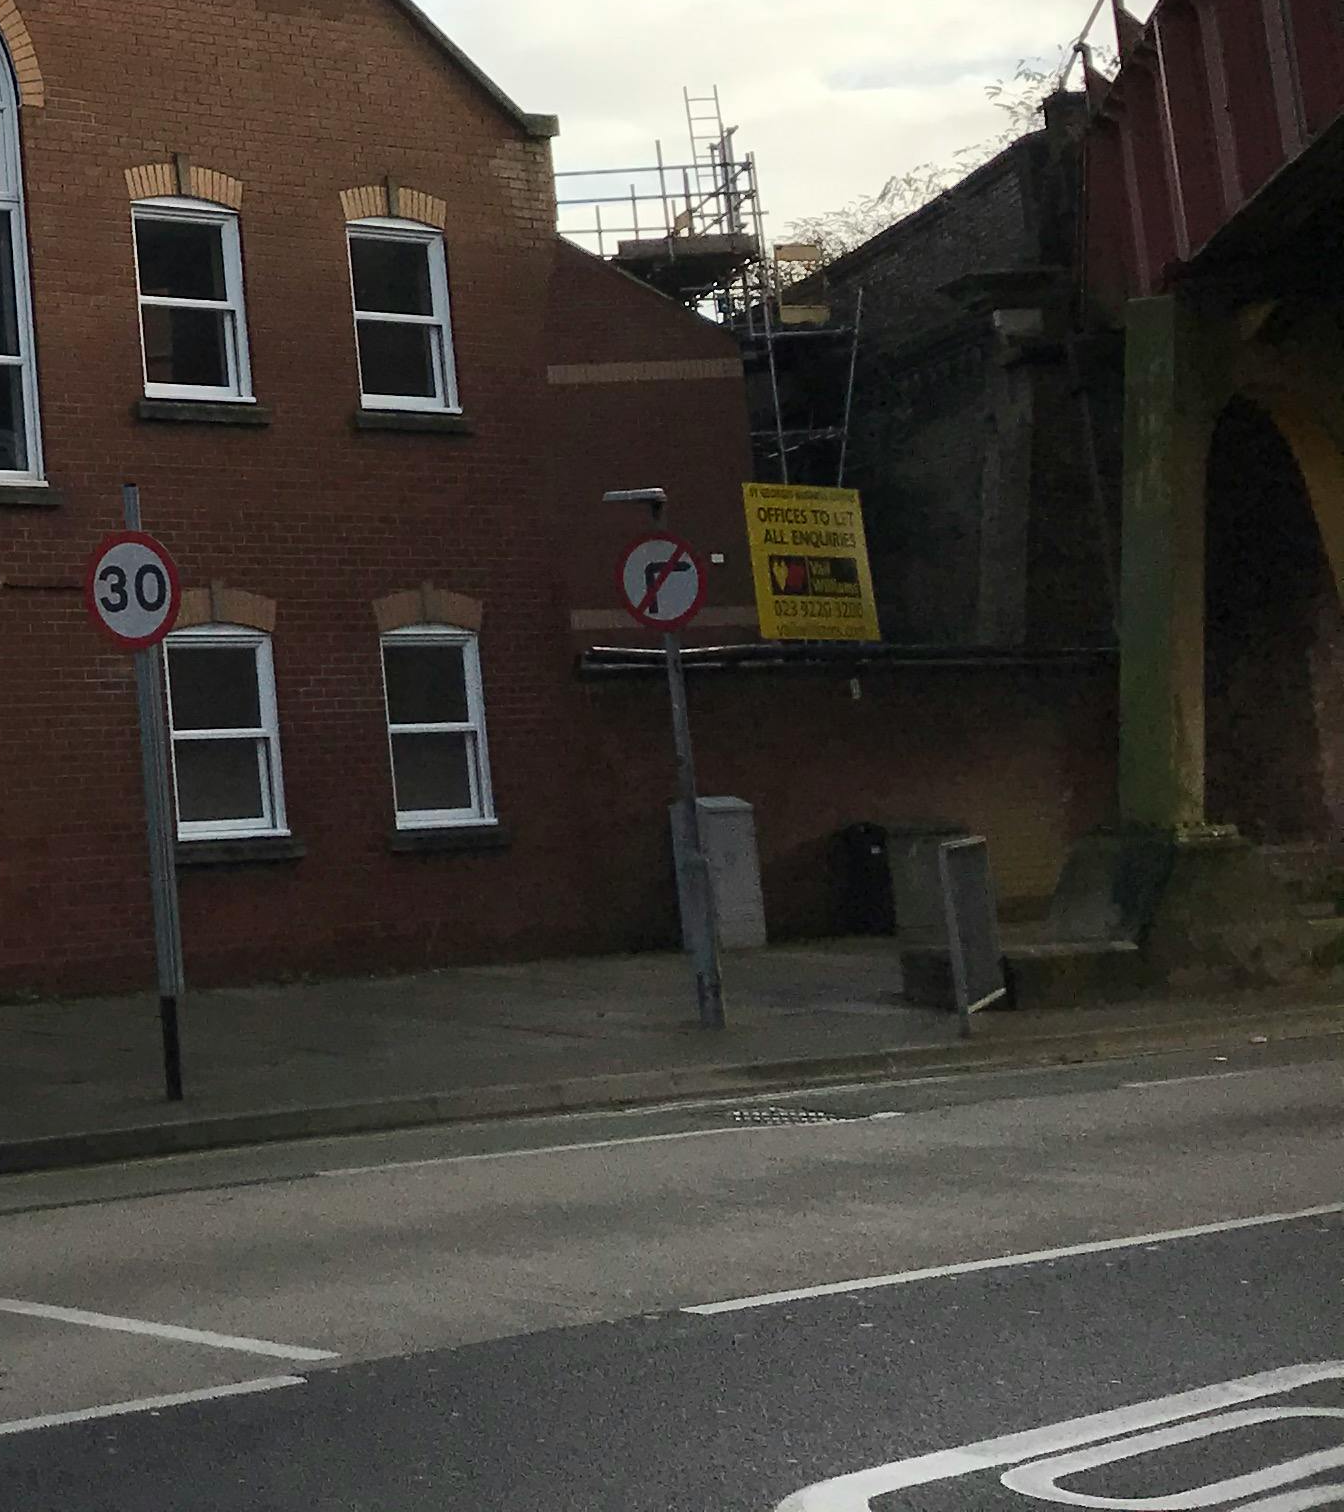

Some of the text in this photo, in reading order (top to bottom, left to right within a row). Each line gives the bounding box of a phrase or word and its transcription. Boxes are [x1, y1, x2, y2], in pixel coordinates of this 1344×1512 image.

[757, 506, 855, 527] OFFICES TO LET
[764, 528, 857, 549] ALL ENQUIRIES
[99, 564, 167, 613] 30
[774, 600, 798, 617] 023
